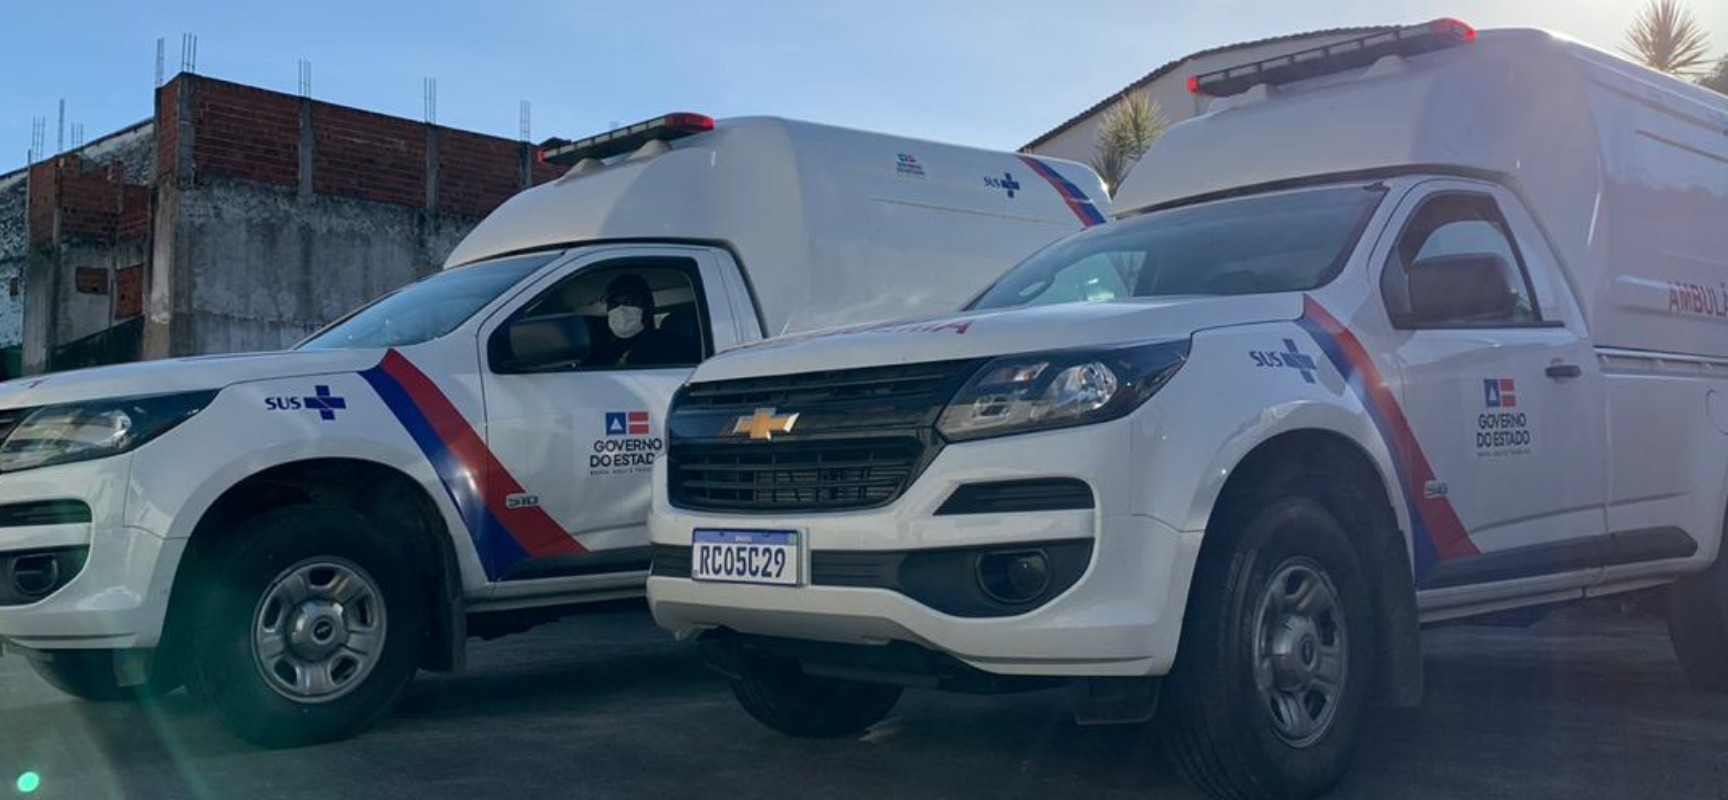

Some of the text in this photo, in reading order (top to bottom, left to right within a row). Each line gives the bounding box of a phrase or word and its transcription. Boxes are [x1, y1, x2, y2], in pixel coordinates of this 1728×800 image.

[1249, 351, 1283, 366] SUS
[265, 396, 301, 410] SUS
[1478, 413, 1527, 429] GOVERNO
[593, 438, 662, 453] GOVERNO
[1477, 430, 1530, 448] DO ESTADO
[589, 452, 655, 468] DO ESTAD
